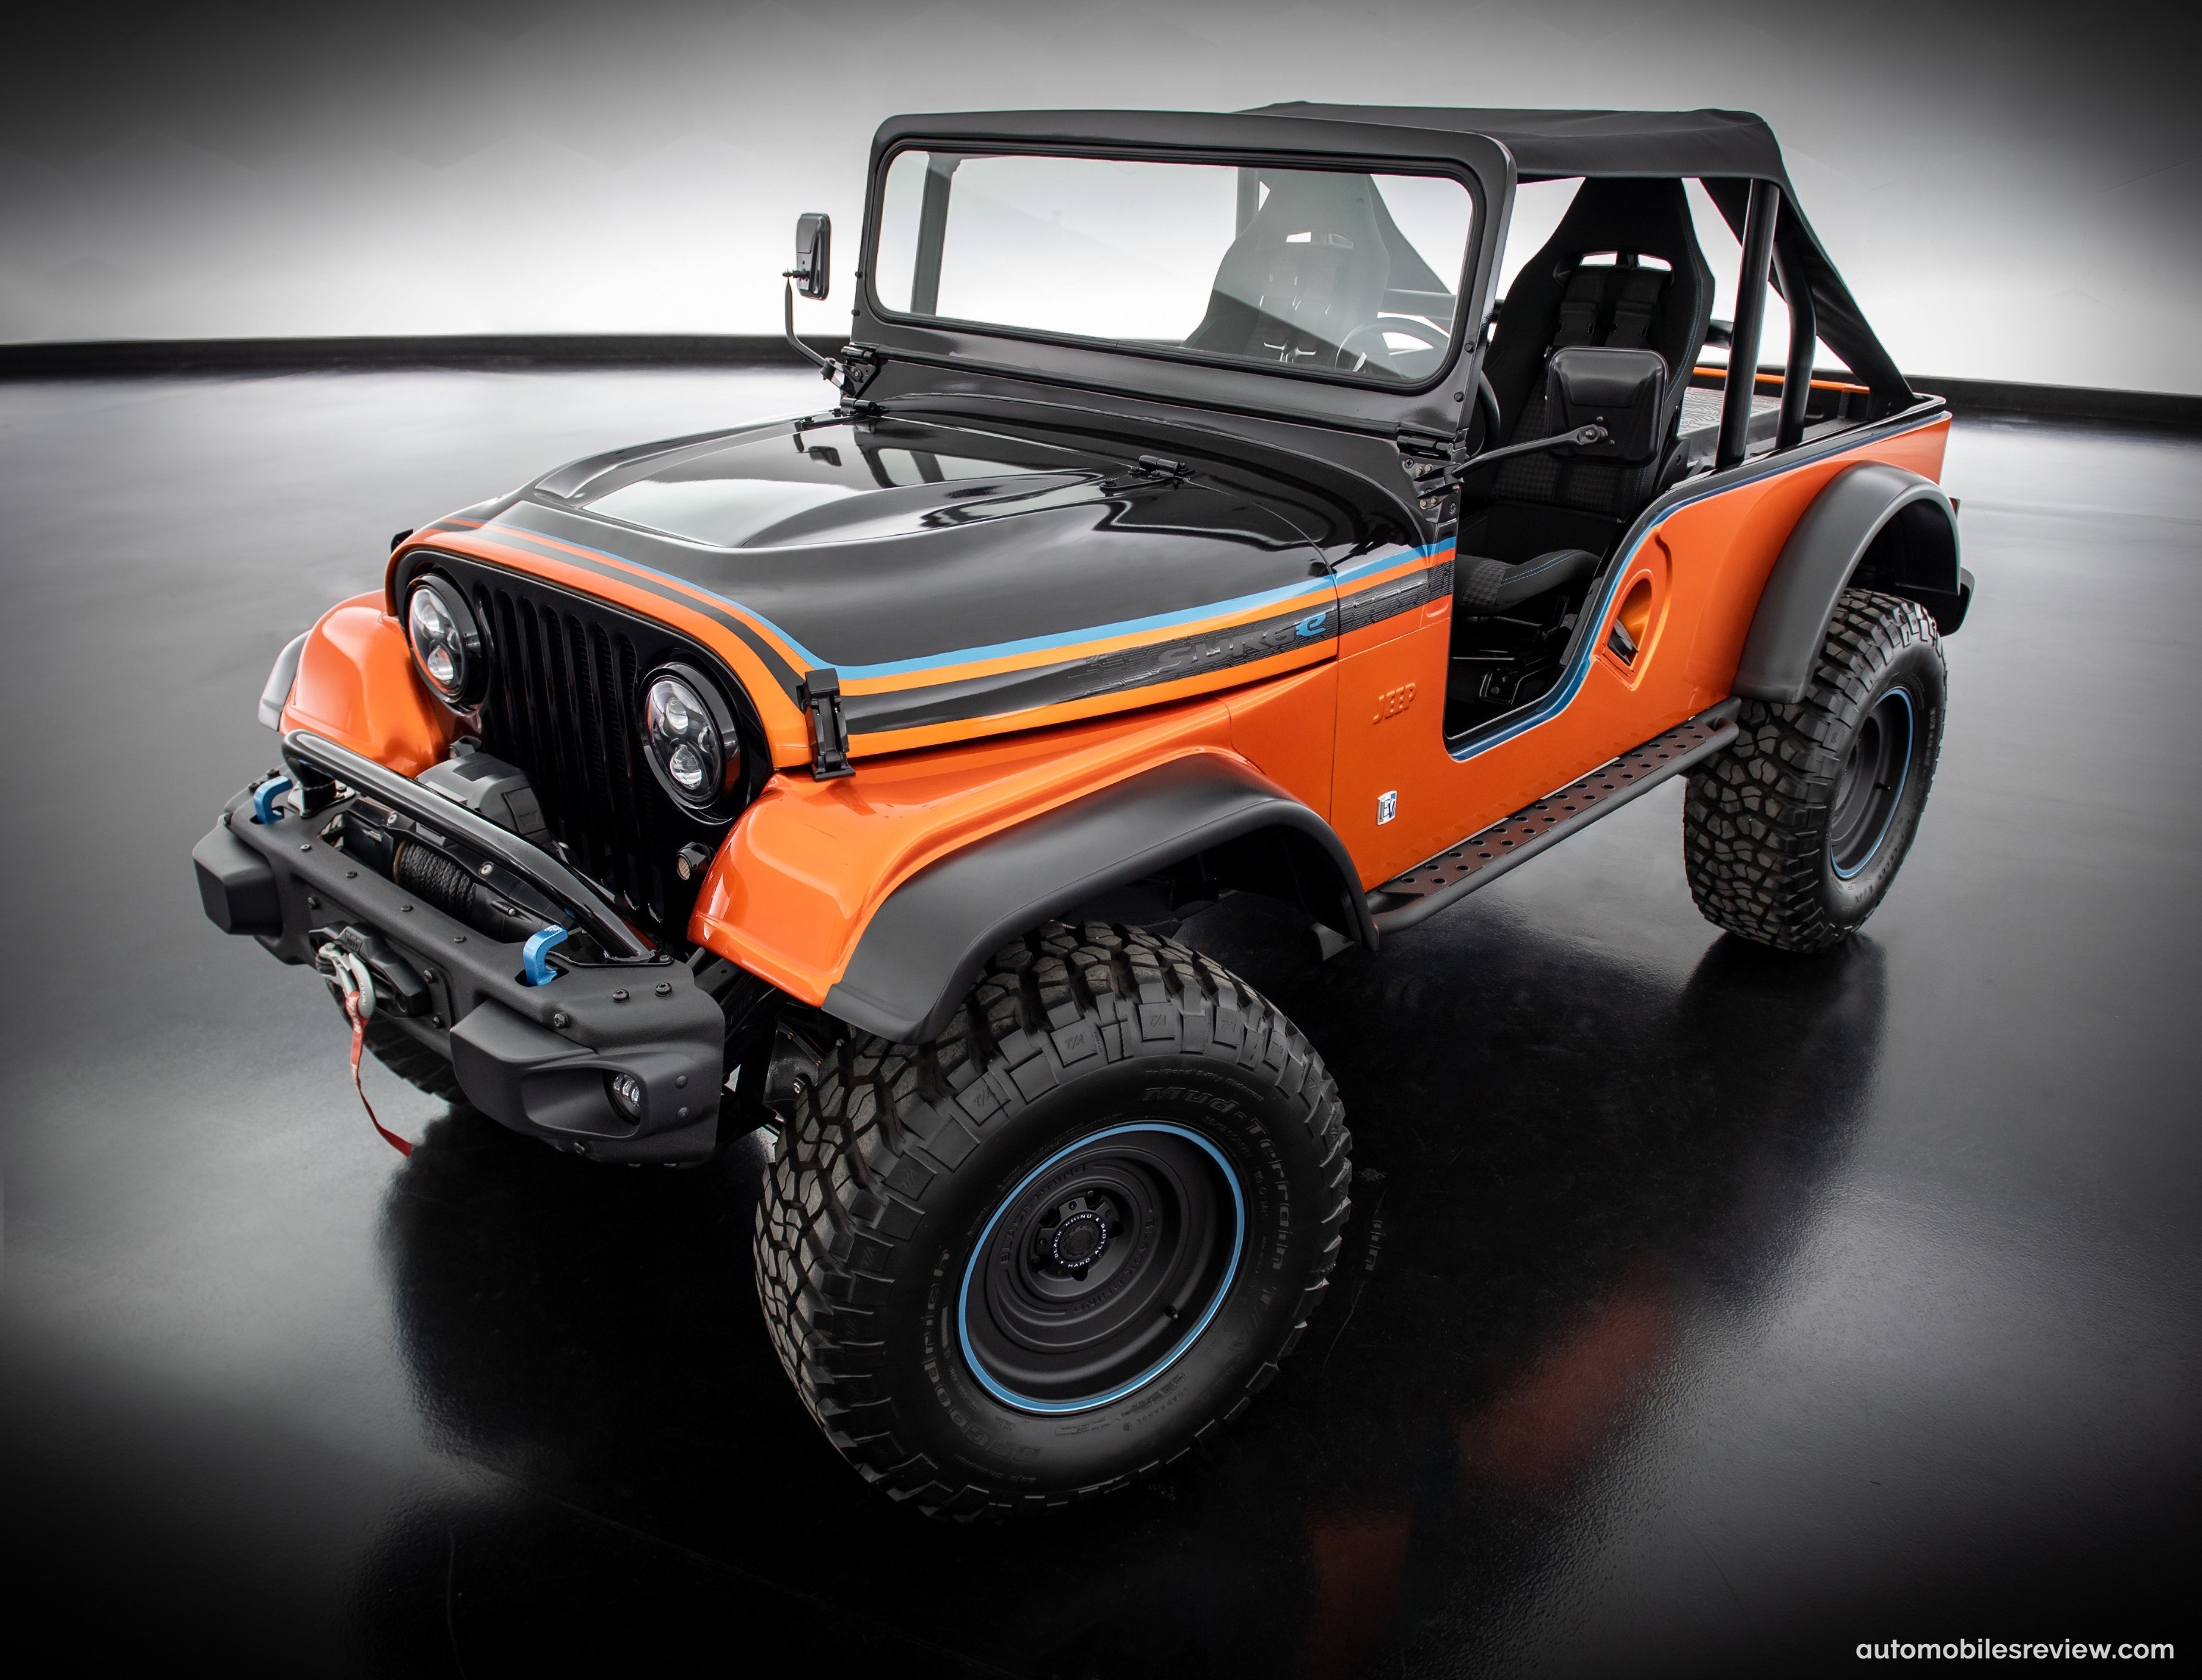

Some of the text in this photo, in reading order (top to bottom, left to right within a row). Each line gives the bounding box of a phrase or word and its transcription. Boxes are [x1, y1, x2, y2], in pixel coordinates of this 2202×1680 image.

[1373, 683, 1416, 724] JEEP
[1053, 1231, 1062, 1258] BLACK
[1067, 1257, 1090, 1268] HARD
